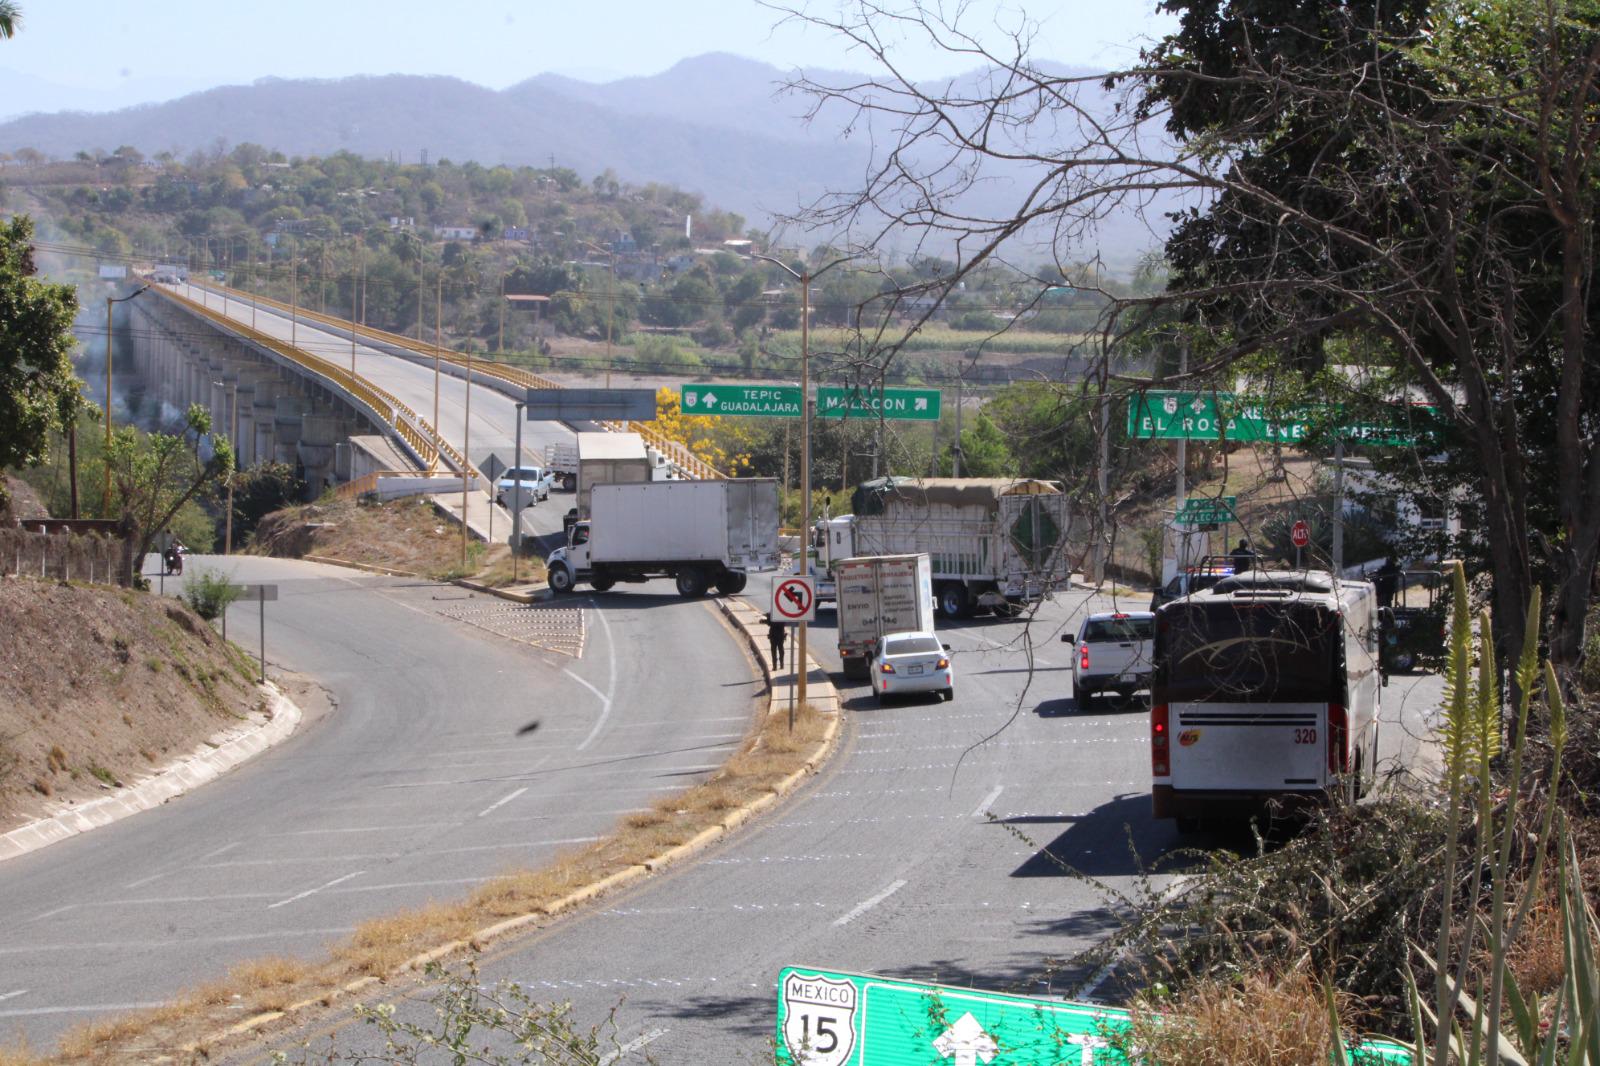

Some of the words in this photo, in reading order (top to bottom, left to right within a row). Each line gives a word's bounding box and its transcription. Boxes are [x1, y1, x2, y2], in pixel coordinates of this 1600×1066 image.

[744, 390, 781, 400] TEPIC
[720, 401, 799, 412] GUADALAJARA
[1142, 417, 1167, 431] EL
[1294, 728, 1317, 744] 320
[791, 983, 849, 1003] MEXICO
[801, 1014, 838, 1053] 15
